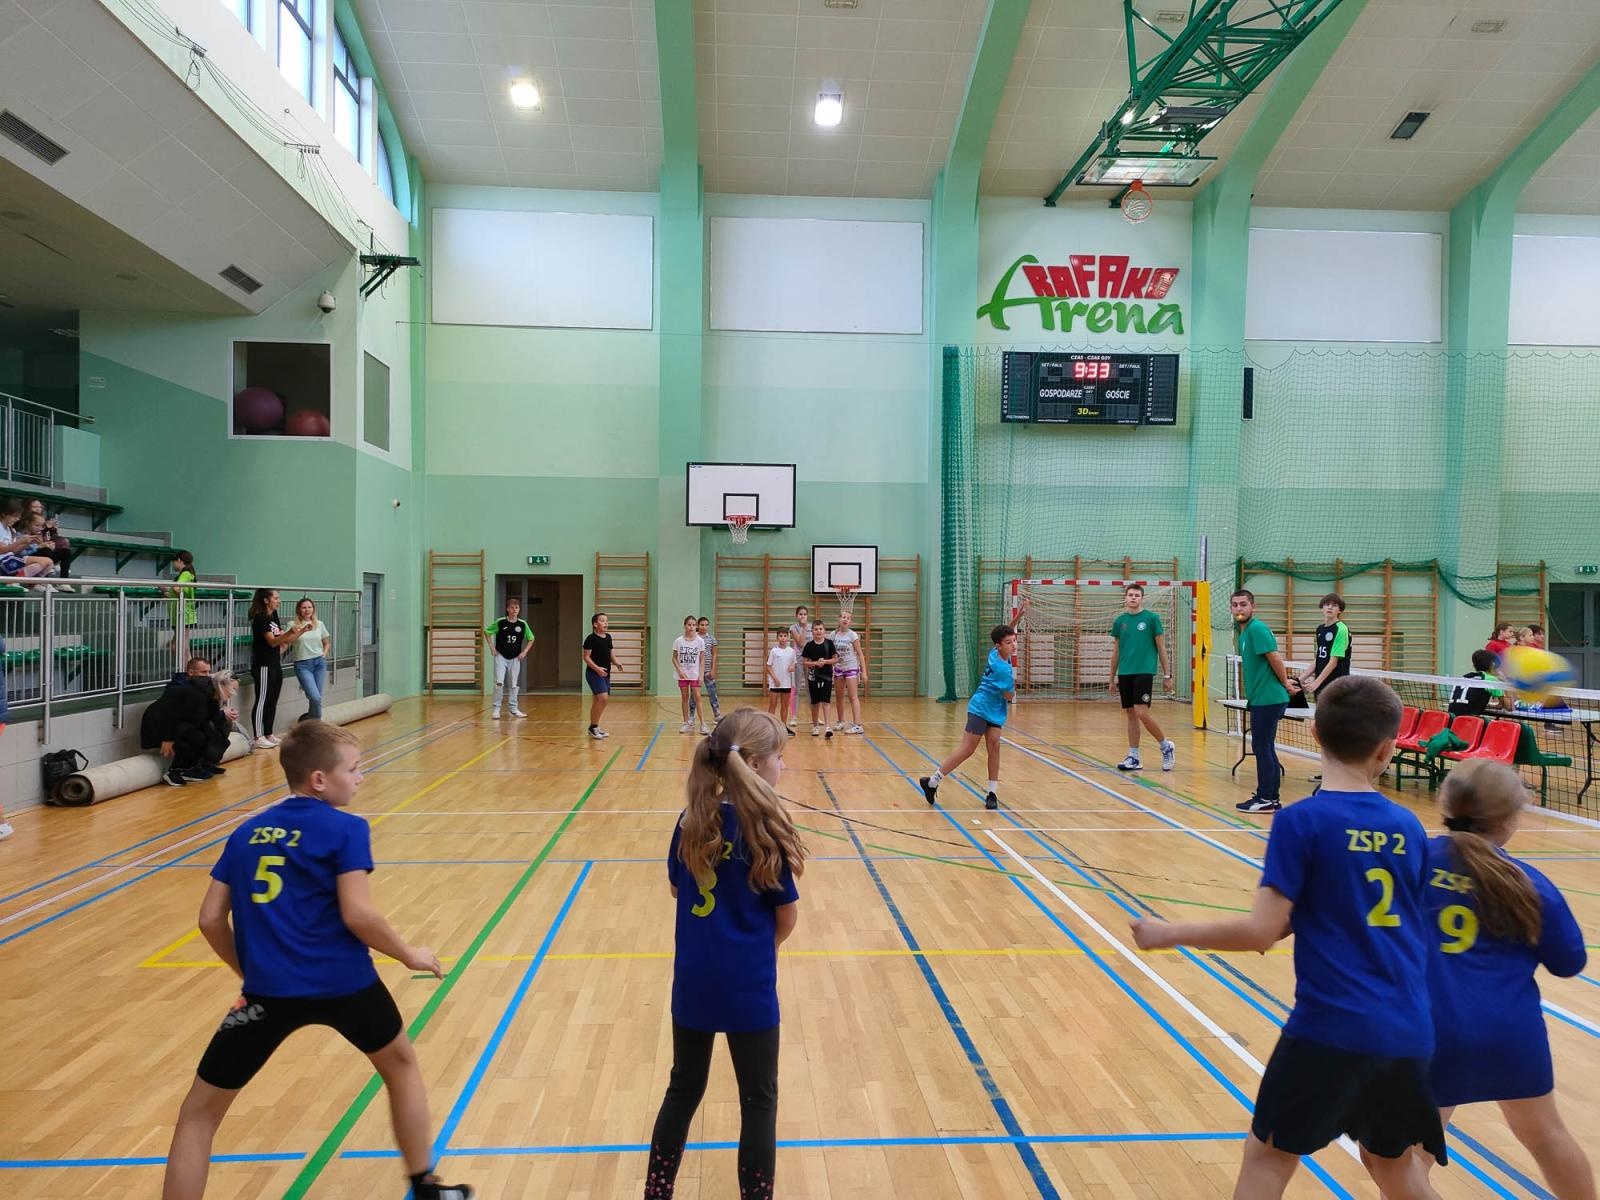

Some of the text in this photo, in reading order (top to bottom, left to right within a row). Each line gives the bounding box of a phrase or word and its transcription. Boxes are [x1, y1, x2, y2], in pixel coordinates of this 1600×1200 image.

[1022, 254, 1180, 299] RAFAKO
[976, 254, 1184, 335] Arena
[1074, 362, 1110, 378] 9:33
[1040, 389, 1083, 398] GOSPODARZE
[1105, 388, 1131, 399] GOŚCIE
[507, 635, 516, 644] 19
[1319, 646, 1327, 658] 15
[249, 827, 302, 847] ZSP 2
[1346, 829, 1406, 855] ZSP 2
[722, 842, 734, 860] 2
[251, 855, 286, 904] 5
[690, 868, 718, 918] 3
[1365, 868, 1401, 927] 2
[1438, 905, 1479, 954] 9
